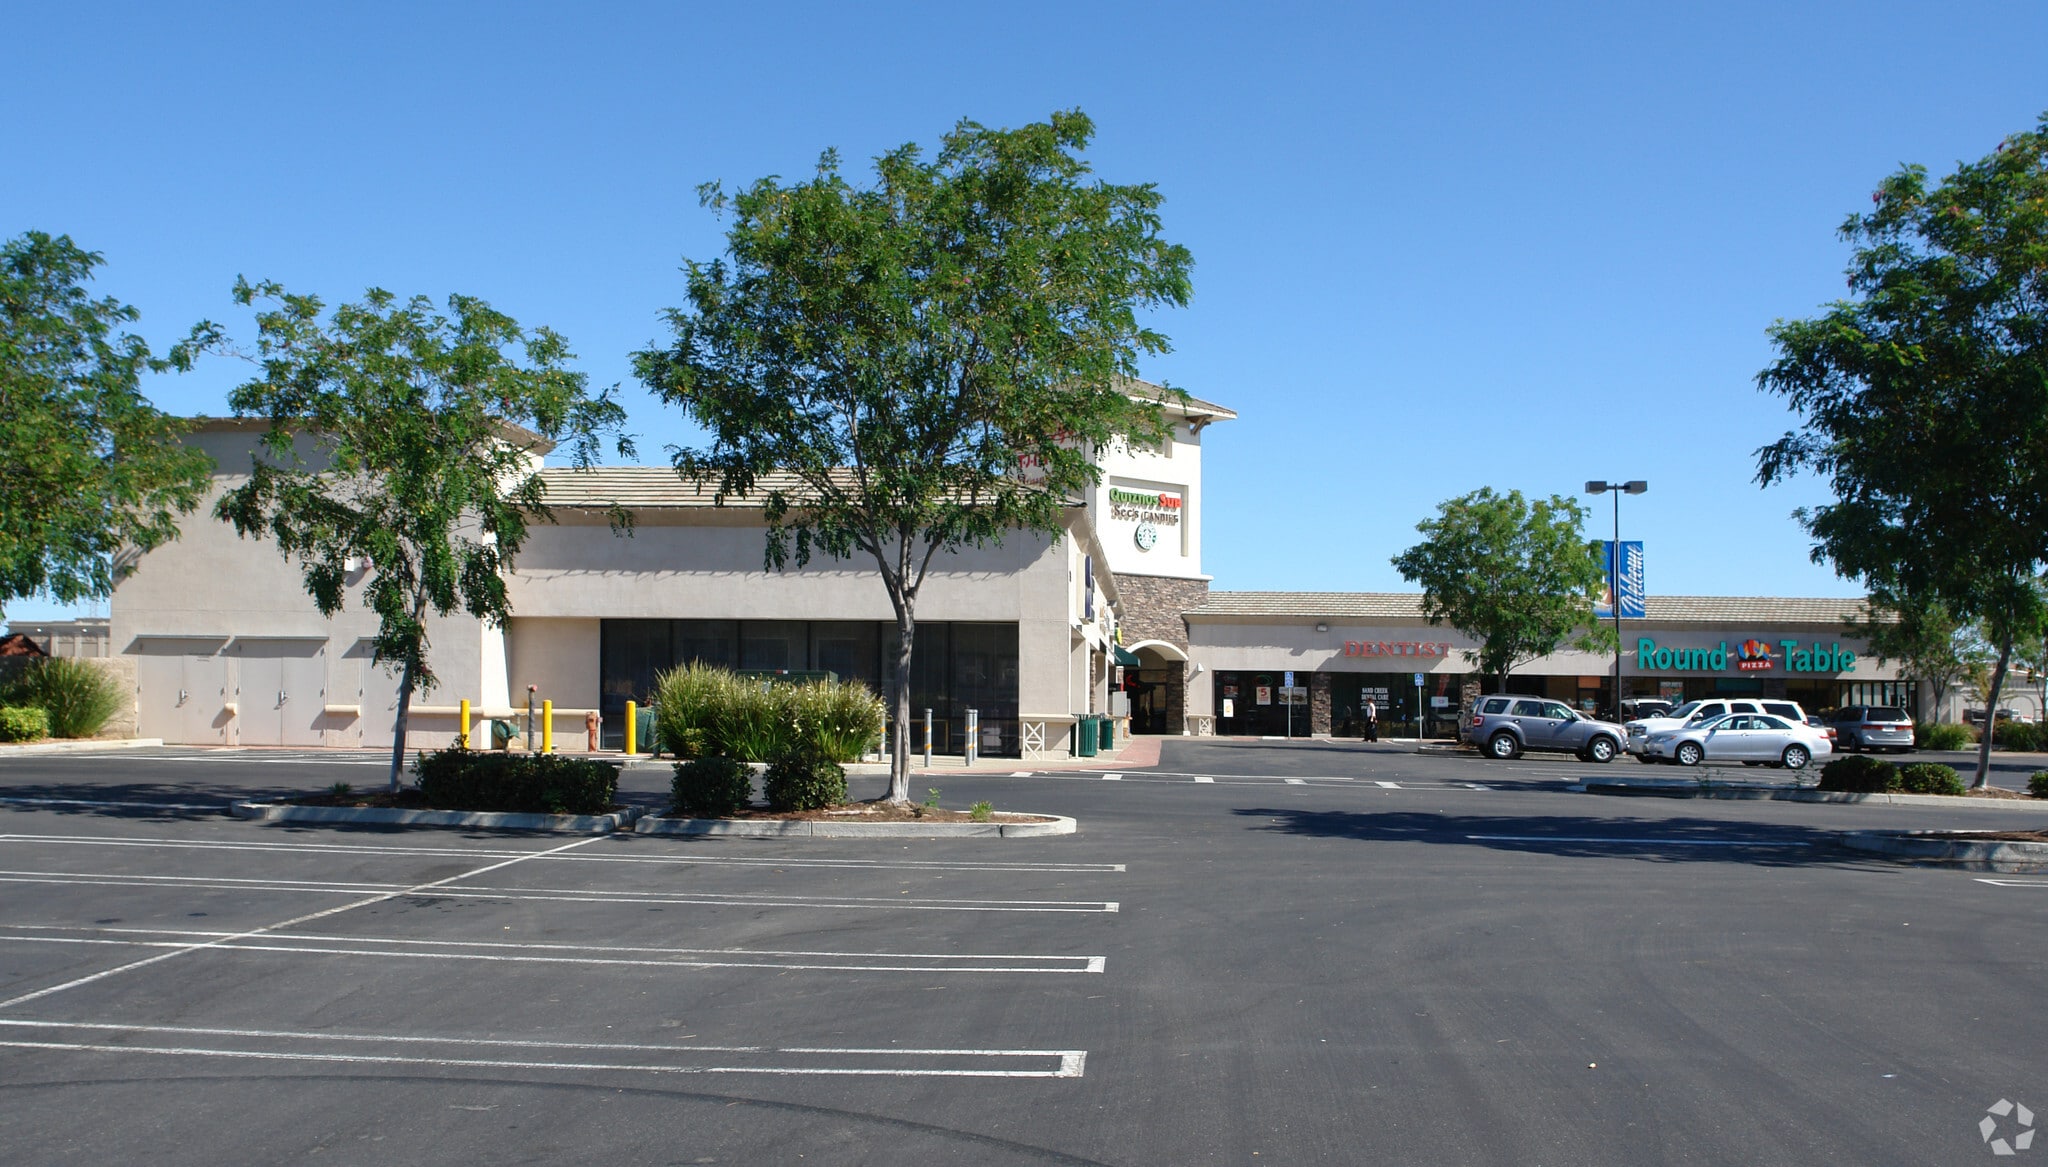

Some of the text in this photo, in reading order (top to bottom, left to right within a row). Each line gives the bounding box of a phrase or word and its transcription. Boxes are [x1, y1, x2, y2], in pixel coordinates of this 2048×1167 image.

[1620, 544, 1644, 614] Welcome
[1344, 641, 1453, 658] DENTIST
[1637, 638, 1856, 672] Round Table
